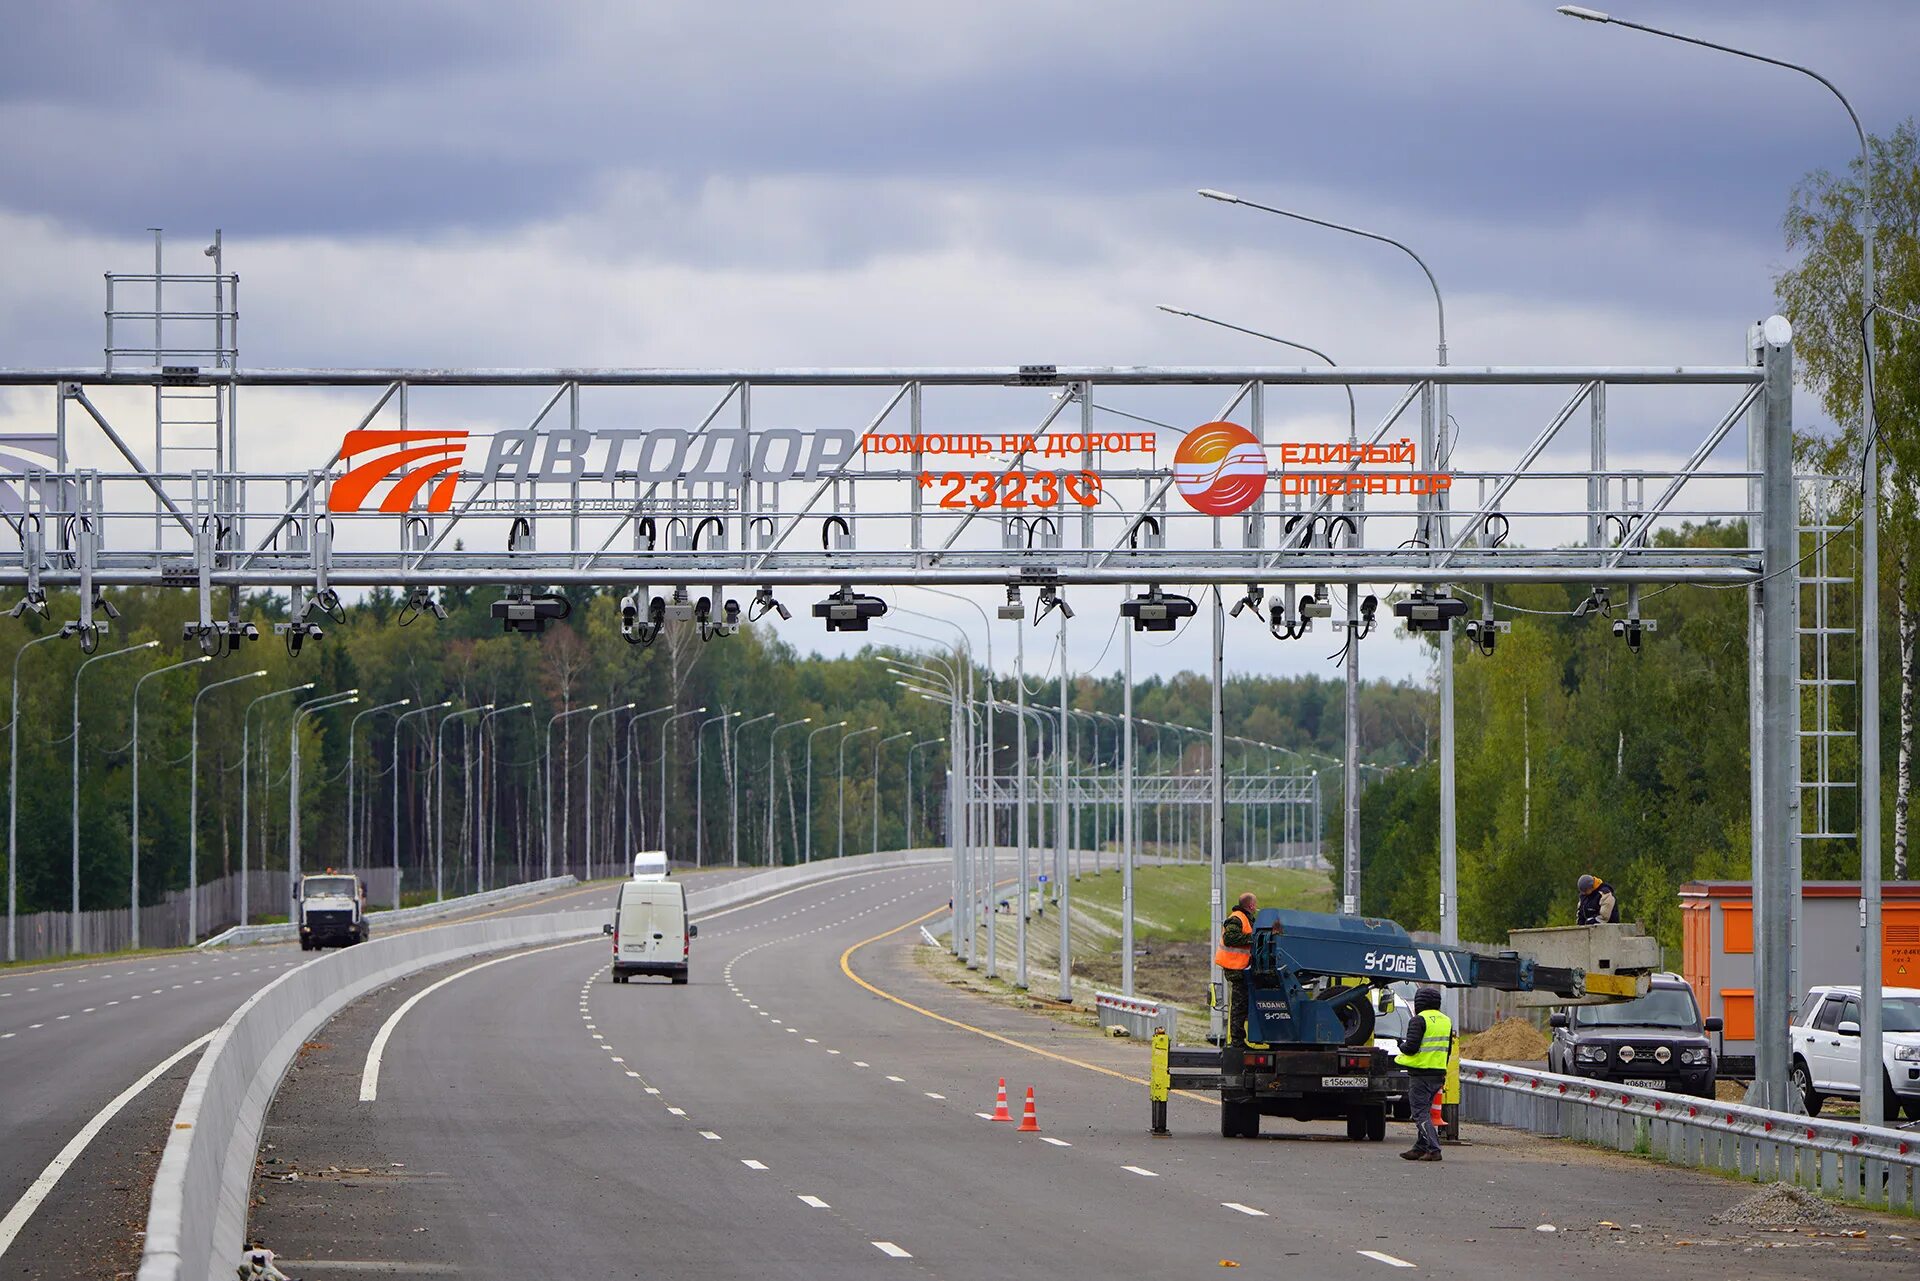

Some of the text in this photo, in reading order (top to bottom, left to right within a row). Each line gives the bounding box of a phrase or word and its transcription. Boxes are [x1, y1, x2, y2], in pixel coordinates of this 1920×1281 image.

[862, 432, 1156, 458] ПОМОЩЬ НА ДОРОГЕ
[1281, 438, 1416, 465] ЕДИНЫЙ
[482, 429, 857, 490] АВТОДОР
[1281, 474, 1452, 496] ОПЕРАТОР
